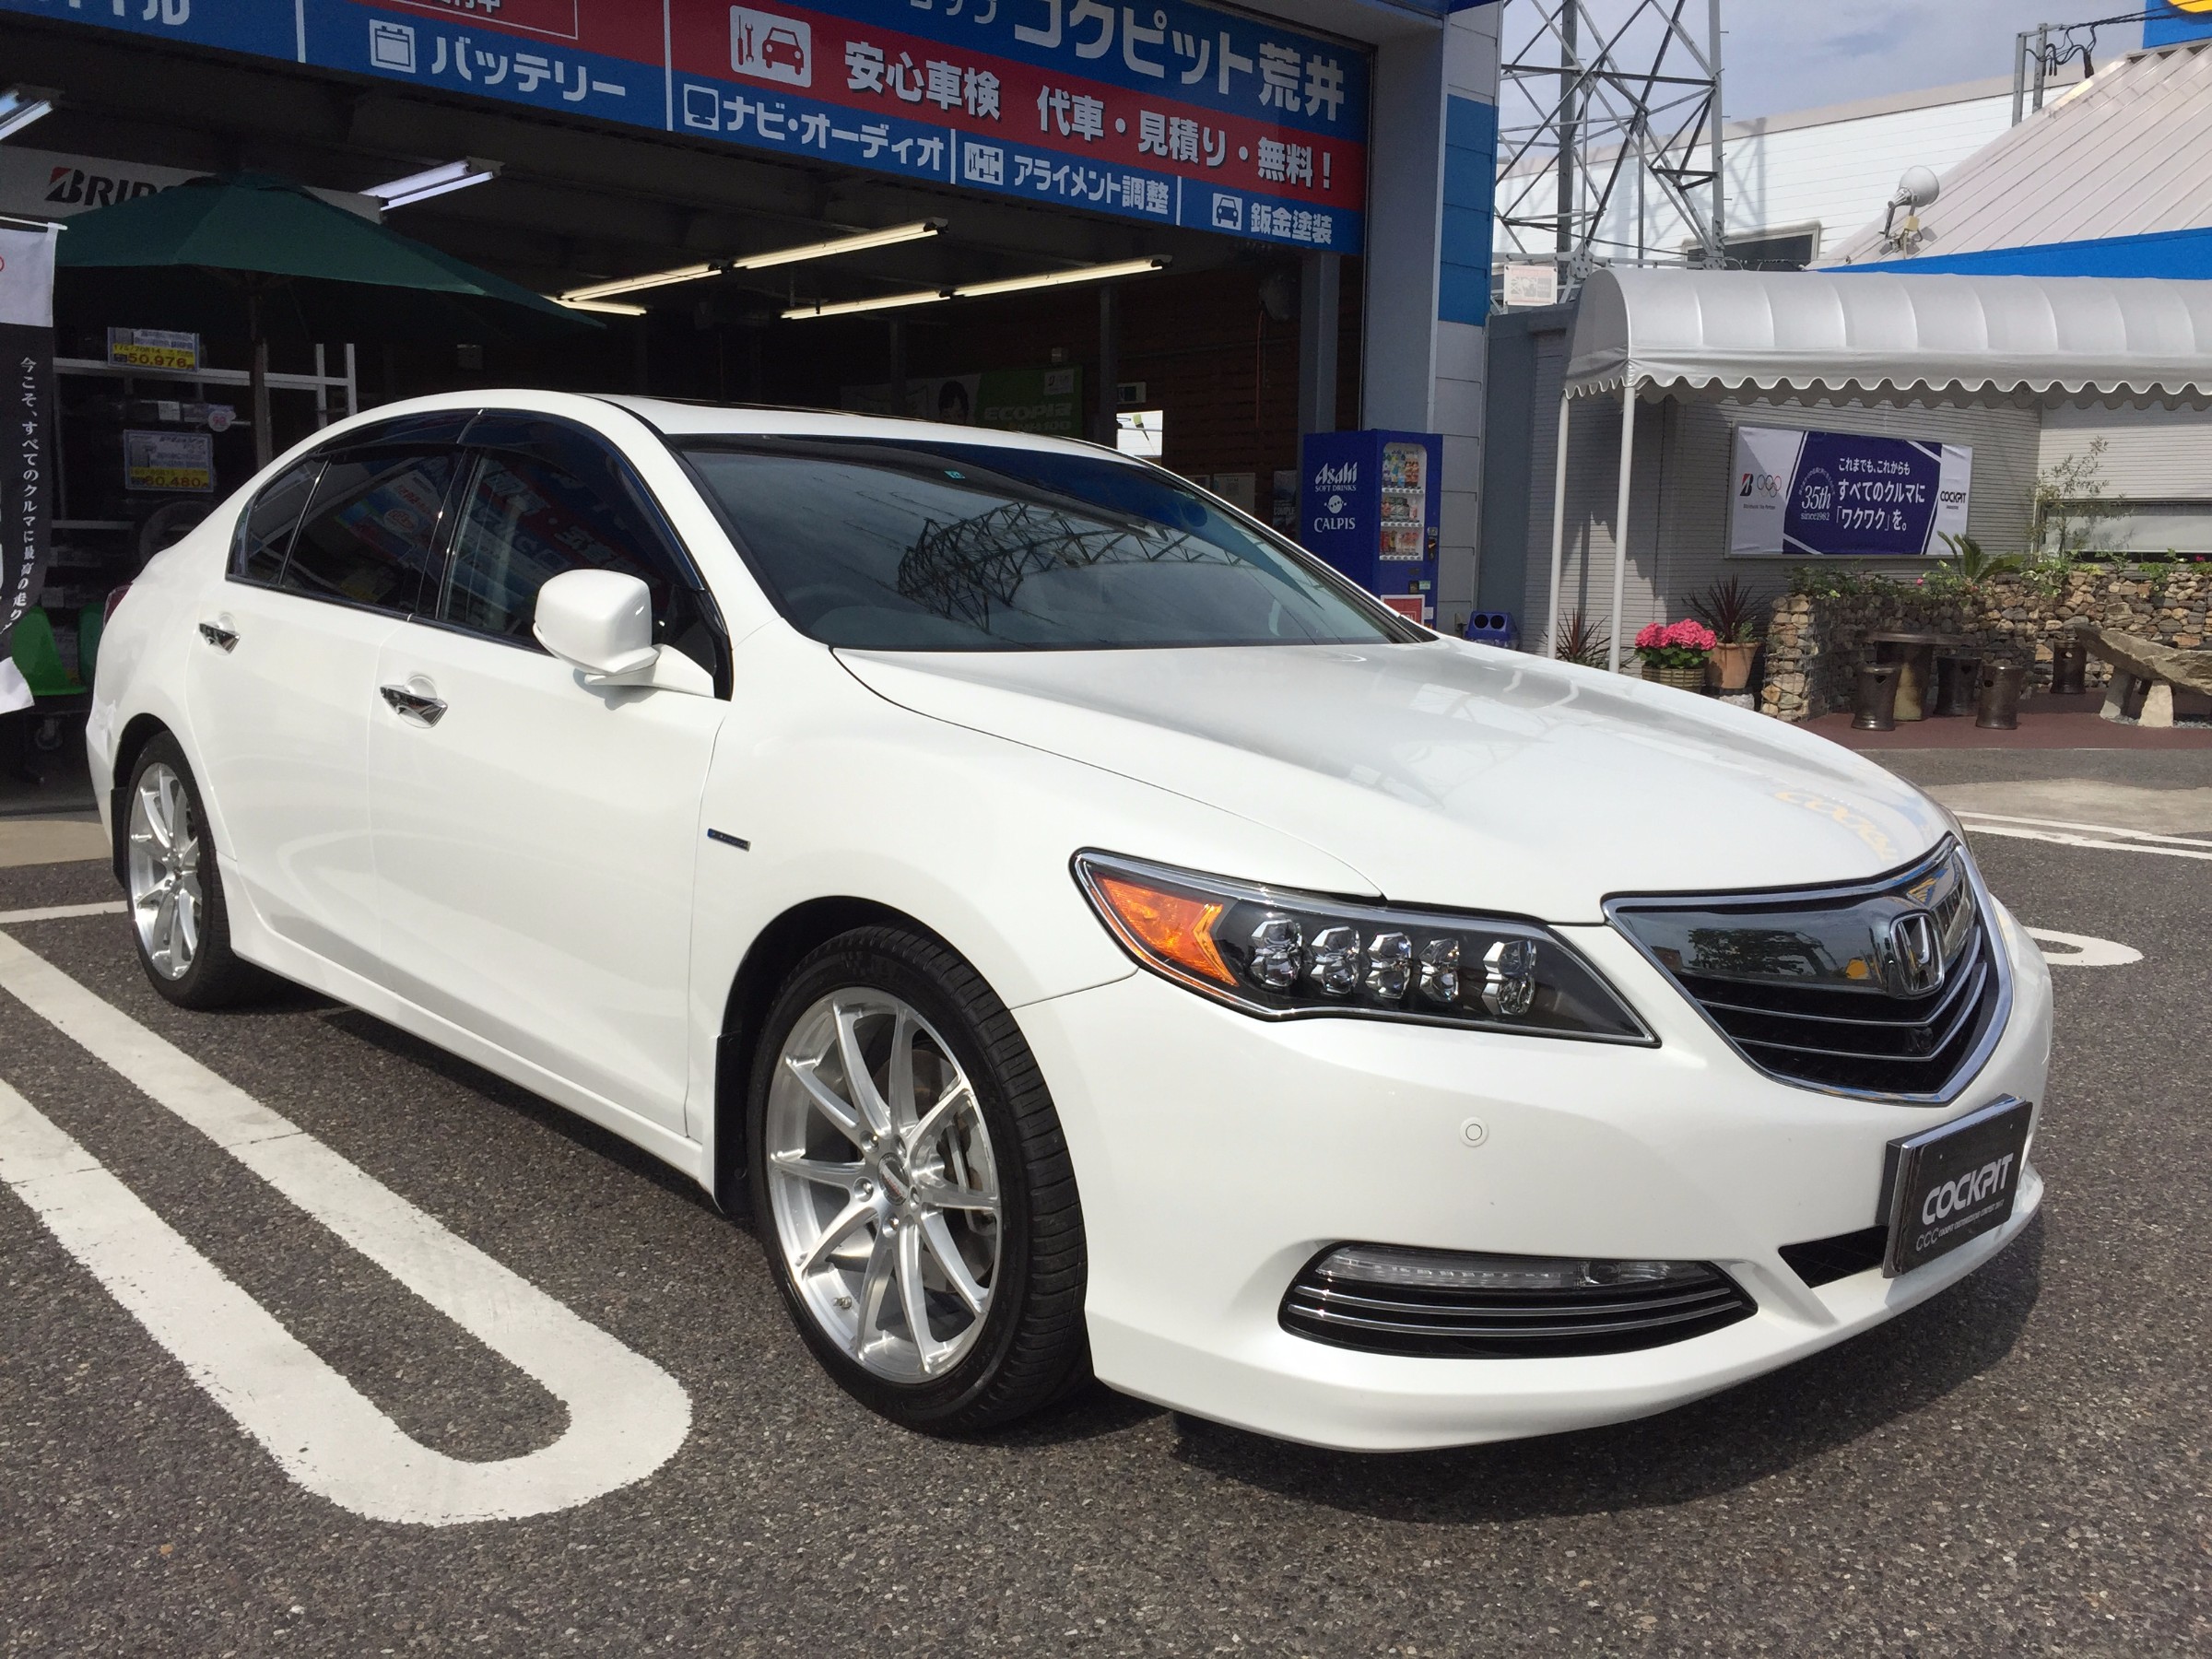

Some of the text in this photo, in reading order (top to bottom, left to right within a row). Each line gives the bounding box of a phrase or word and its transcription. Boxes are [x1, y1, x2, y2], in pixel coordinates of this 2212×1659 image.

[431, 36, 626, 101] バッテリー
[844, 41, 1001, 122] 安心車検
[724, 96, 944, 171] ナビ・オーディオ
[1014, 155, 1169, 215] アライメント調整
[1250, 202, 1333, 245] 鈑金塗装
[1315, 462, 1358, 485] Asahi
[1839, 457, 1911, 476] これまでも、これからも
[1801, 485, 1832, 511] 35th
[1838, 478, 1925, 503] すべてのクルマに
[1940, 490, 1967, 504] COCKPIT
[1314, 517, 1356, 533] CALPIS
[1836, 505, 1907, 532] 「ワクワク」を。
[1922, 1153, 2014, 1226] COCKPIT
[1915, 1227, 1939, 1252] CCC
